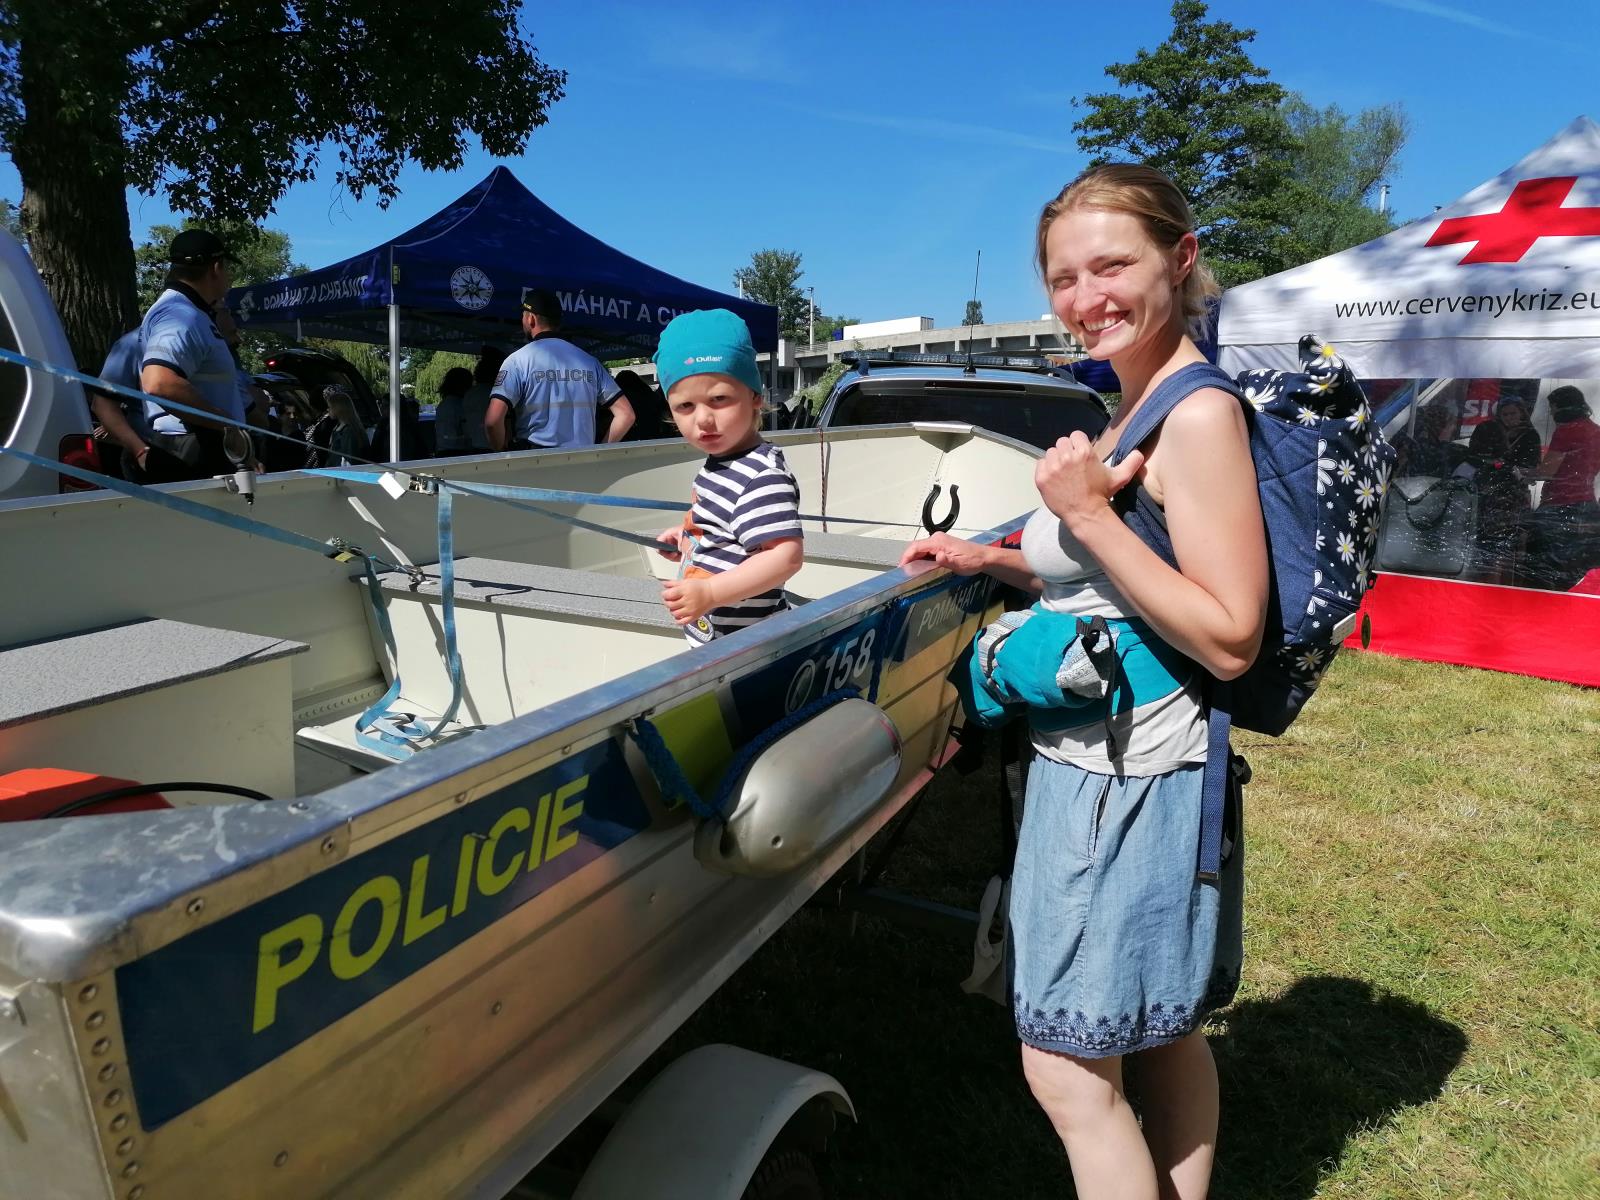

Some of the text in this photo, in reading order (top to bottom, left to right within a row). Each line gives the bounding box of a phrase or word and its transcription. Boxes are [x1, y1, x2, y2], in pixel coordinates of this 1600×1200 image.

[521, 286, 632, 319] MÁHAT
[636, 304, 652, 323] A
[1335, 288, 1600, 318] www.cervenykriz.eu
[534, 369, 594, 383] POLICIE
[823, 628, 876, 698] 158
[253, 775, 590, 1034] POLICIE
